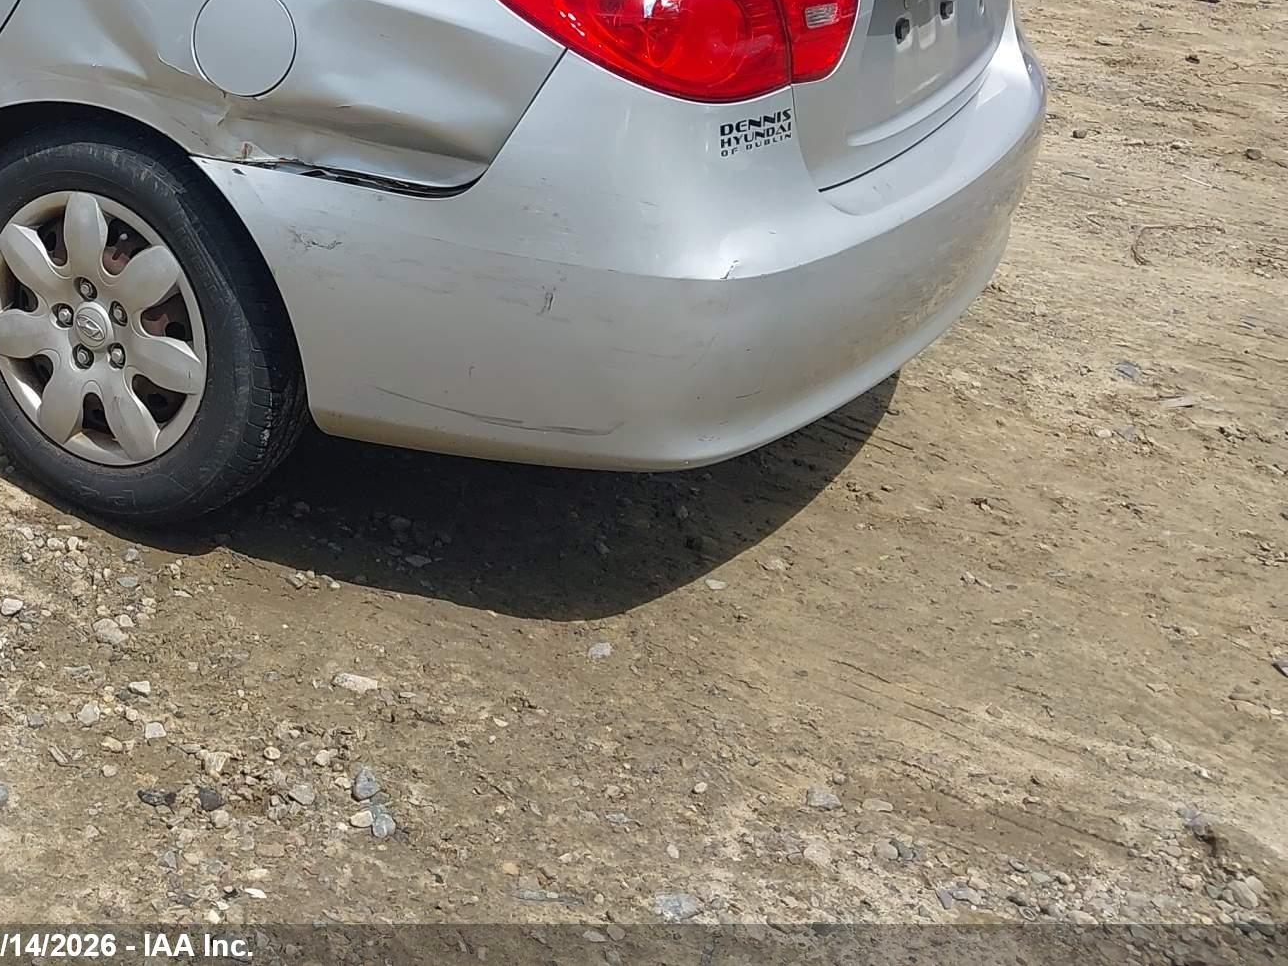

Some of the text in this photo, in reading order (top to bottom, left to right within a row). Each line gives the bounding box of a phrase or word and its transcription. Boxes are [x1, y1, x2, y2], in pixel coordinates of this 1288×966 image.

[719, 108, 792, 136] DENNIS
[720, 121, 792, 149] HYUNDAI
[720, 132, 792, 157] OF DUBLIN
